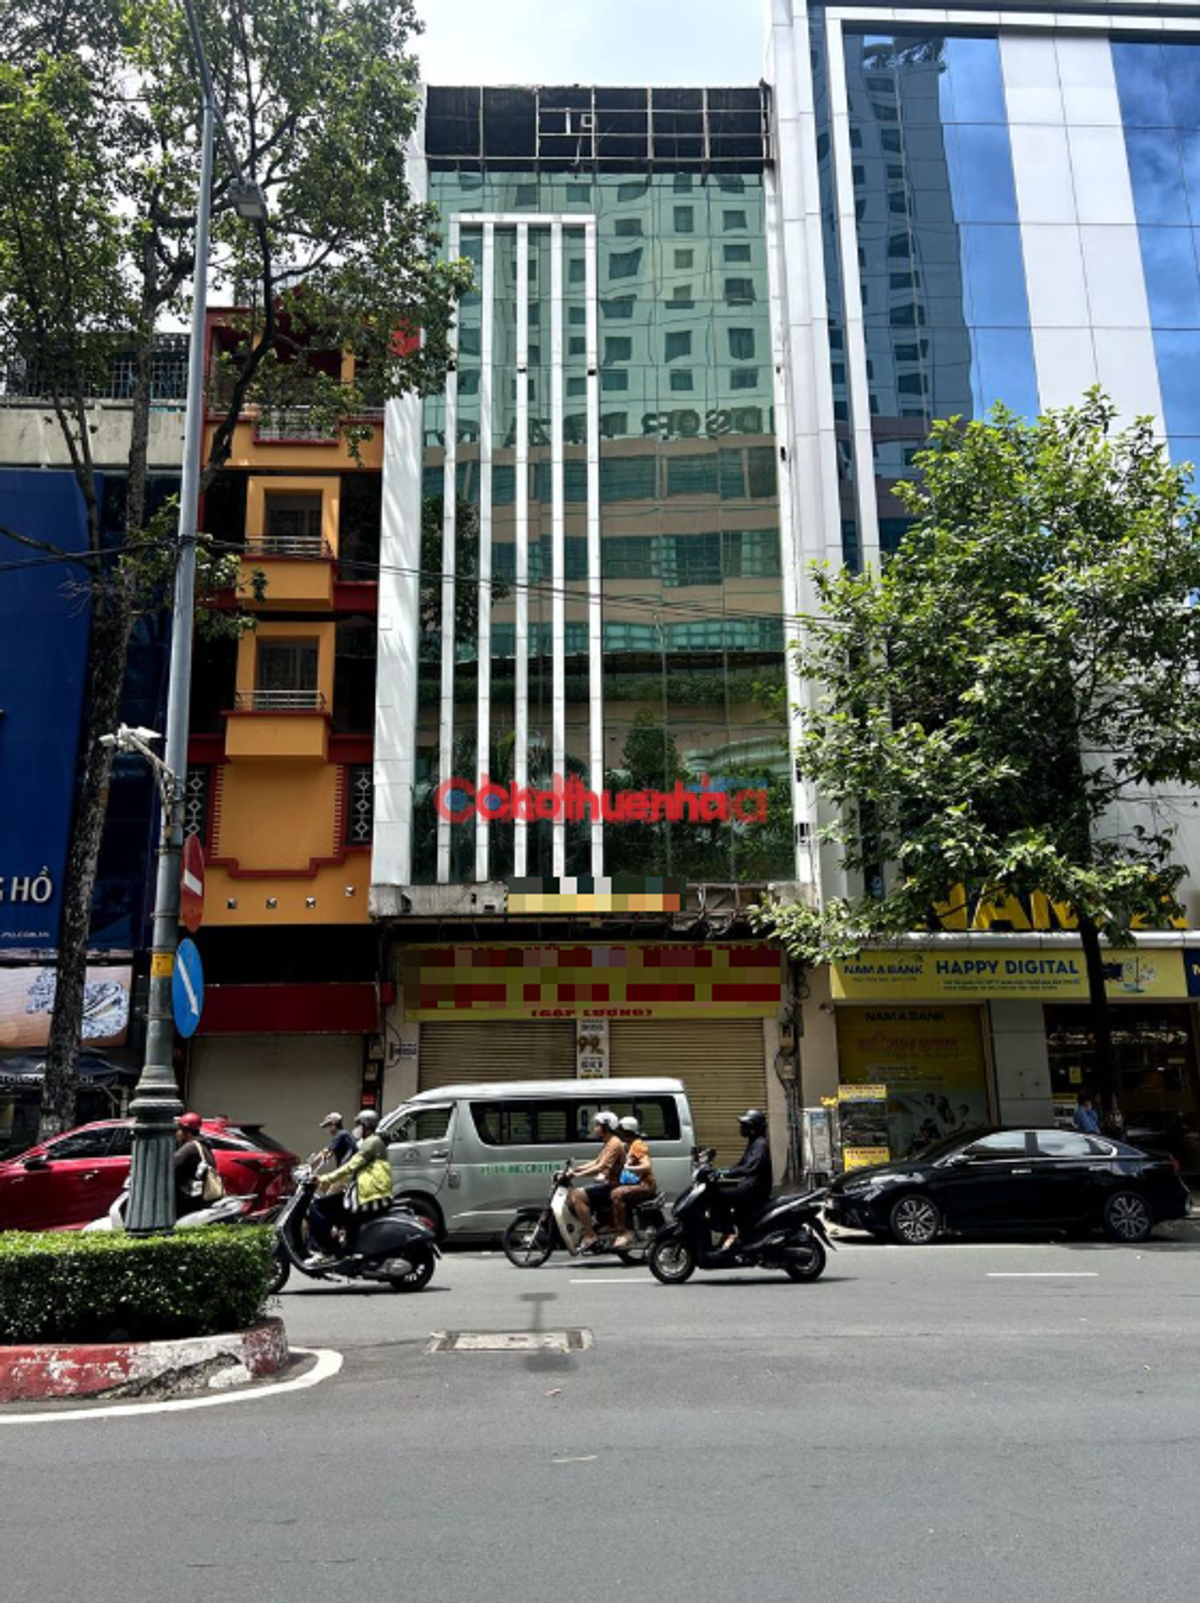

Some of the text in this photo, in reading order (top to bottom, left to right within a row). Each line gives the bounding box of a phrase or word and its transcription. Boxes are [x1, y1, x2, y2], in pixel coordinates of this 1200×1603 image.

[10, 865, 53, 903] HỒ
[844, 964, 923, 974] NAM A BANK
[936, 959, 1079, 974] HAPPY DIGITAL
